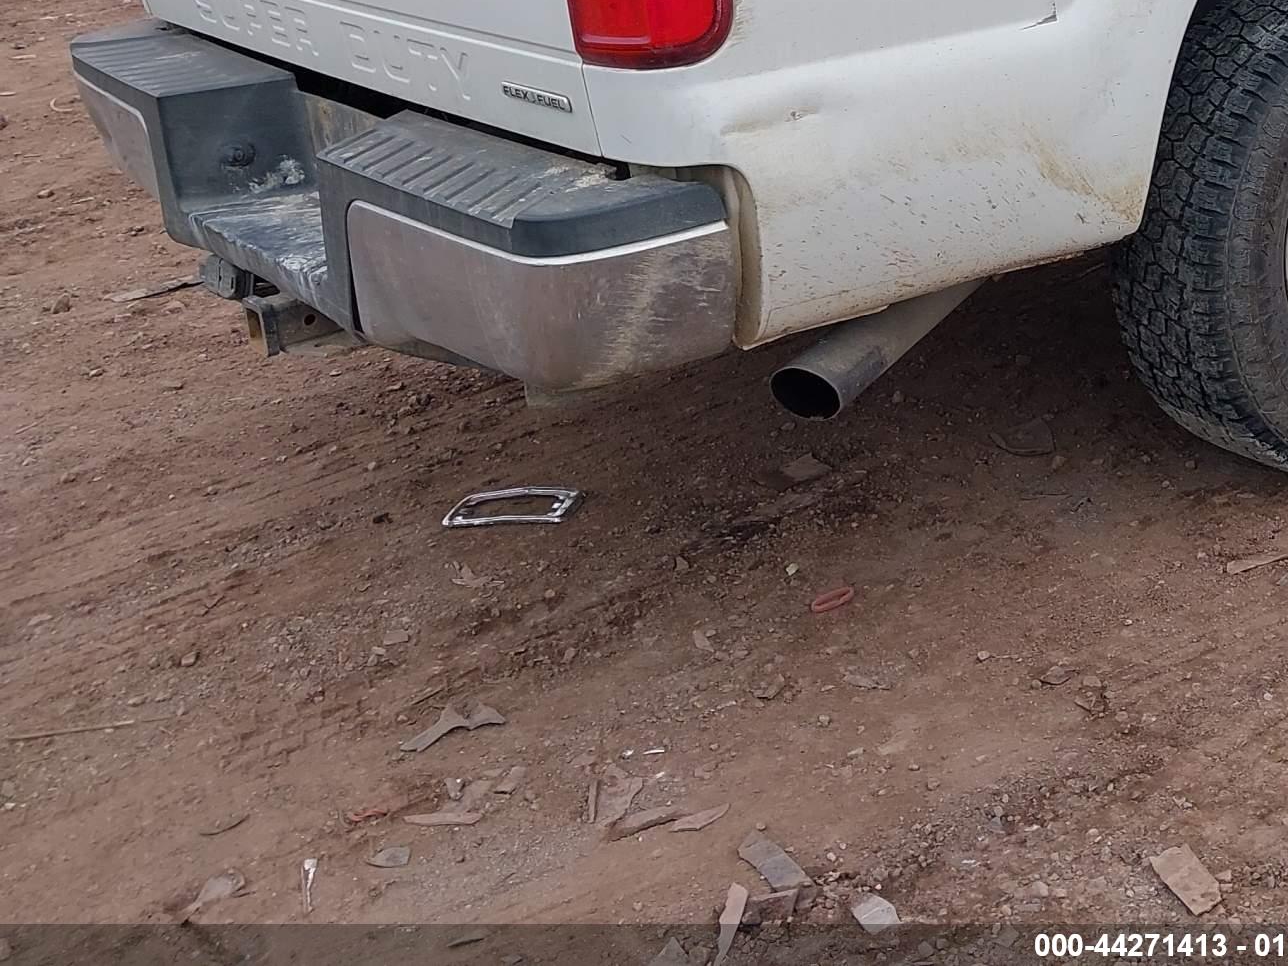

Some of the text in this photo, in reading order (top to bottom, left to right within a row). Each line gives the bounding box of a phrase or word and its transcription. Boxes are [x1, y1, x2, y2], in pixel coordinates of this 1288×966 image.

[339, 21, 470, 100] DUTY
[503, 85, 565, 111] FLEX FUEL
